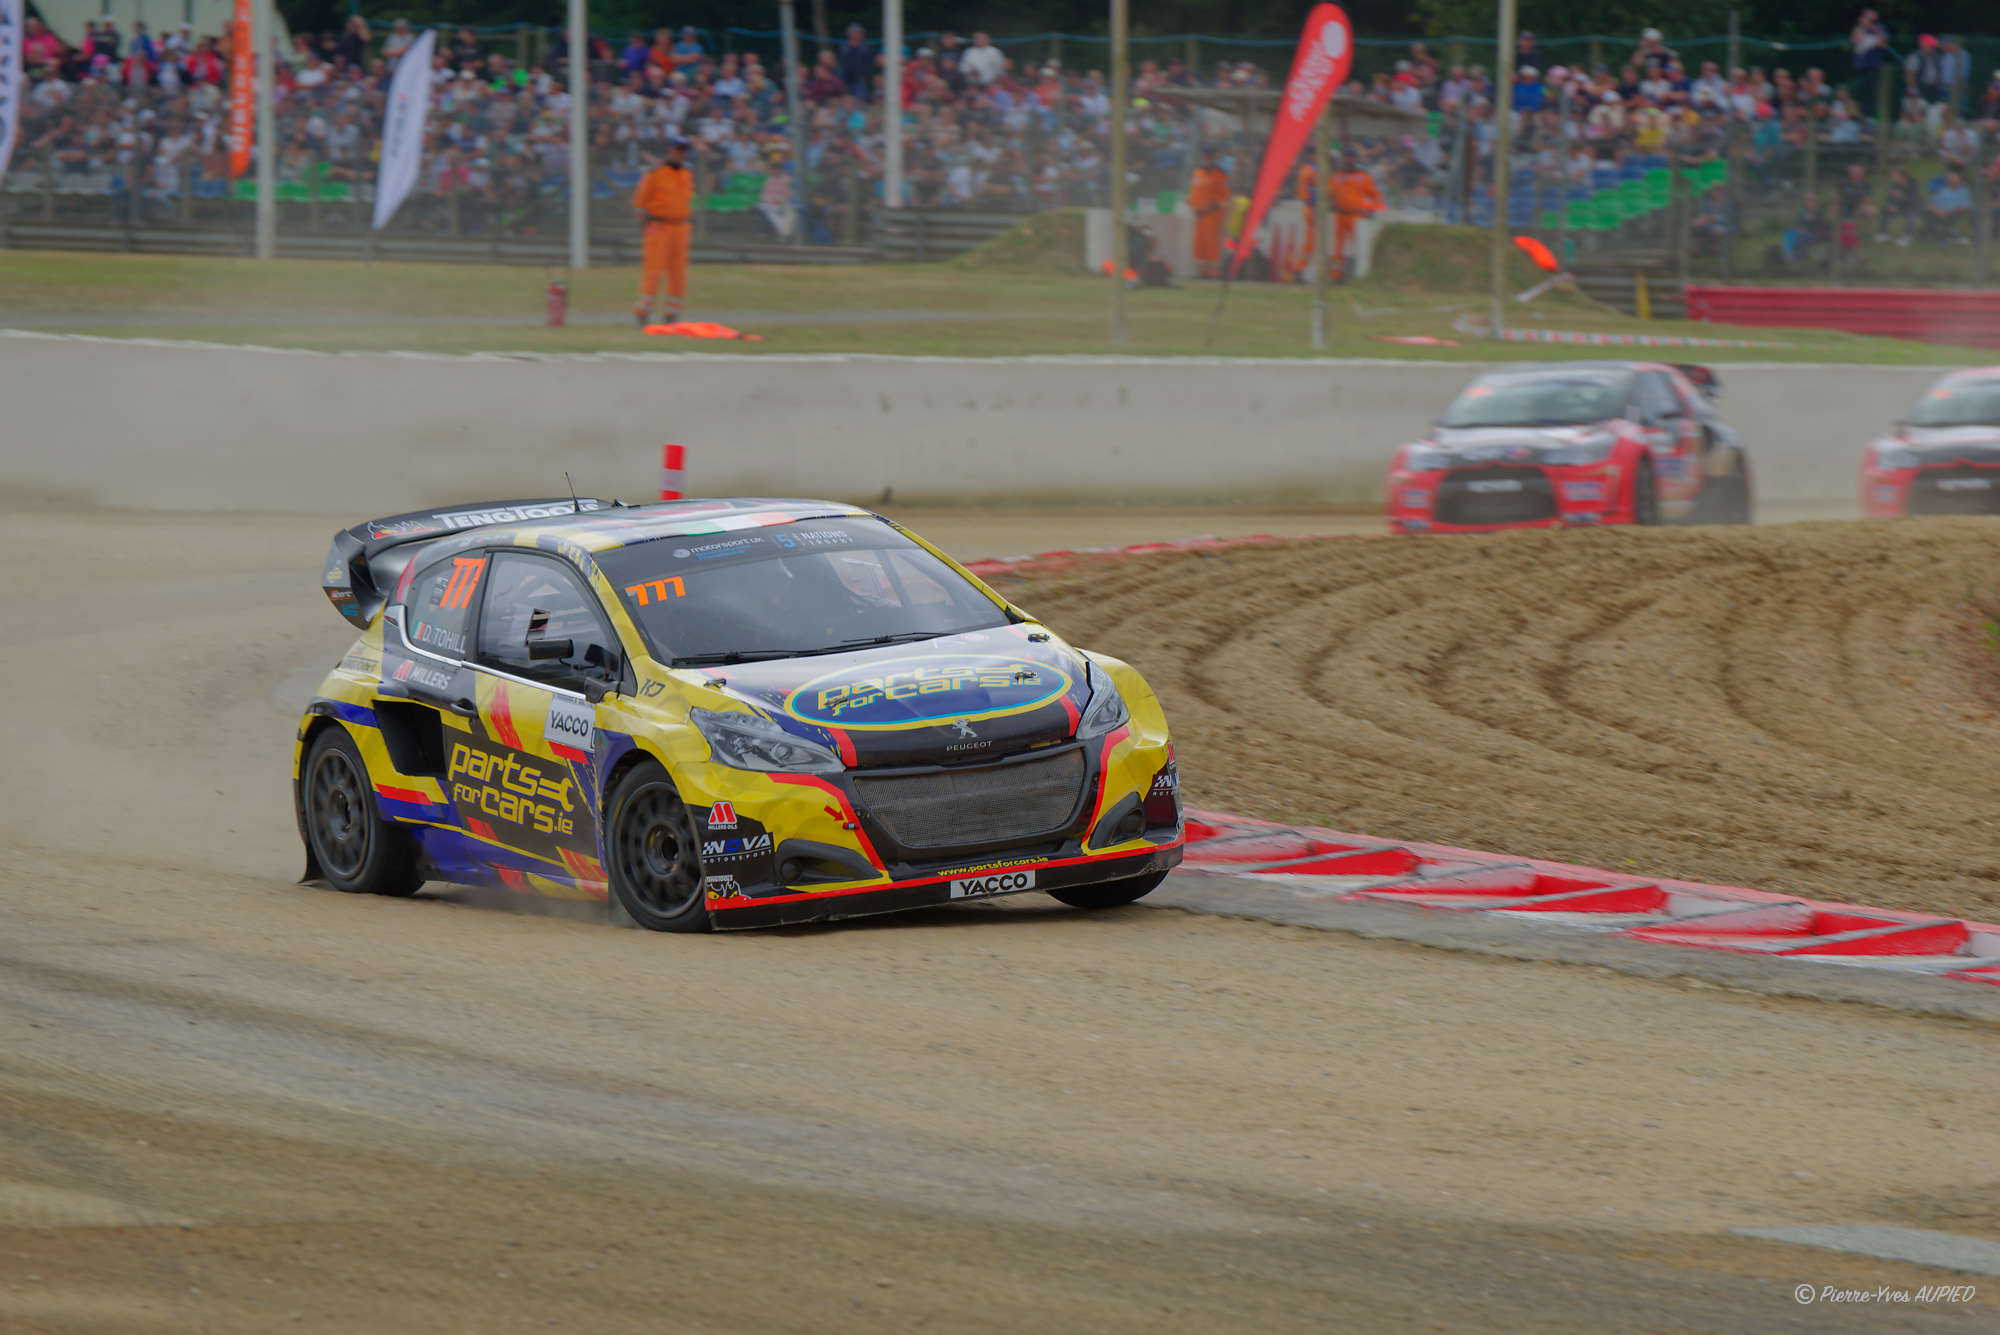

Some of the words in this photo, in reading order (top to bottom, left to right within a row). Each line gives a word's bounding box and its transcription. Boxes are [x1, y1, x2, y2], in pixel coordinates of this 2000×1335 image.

[776, 533, 795, 548] 5
[440, 557, 487, 608] 777
[626, 576, 686, 606] 777
[433, 627, 466, 654] TOHILL
[410, 665, 452, 690] MILLERS
[818, 666, 974, 711] parts
[551, 710, 589, 737] YACCO
[946, 741, 993, 753] PEUGEOT
[448, 743, 542, 797] parts
[453, 782, 481, 804] for
[937, 856, 1049, 877] www.partsforcars.ie
[960, 872, 1028, 896] YACCO
